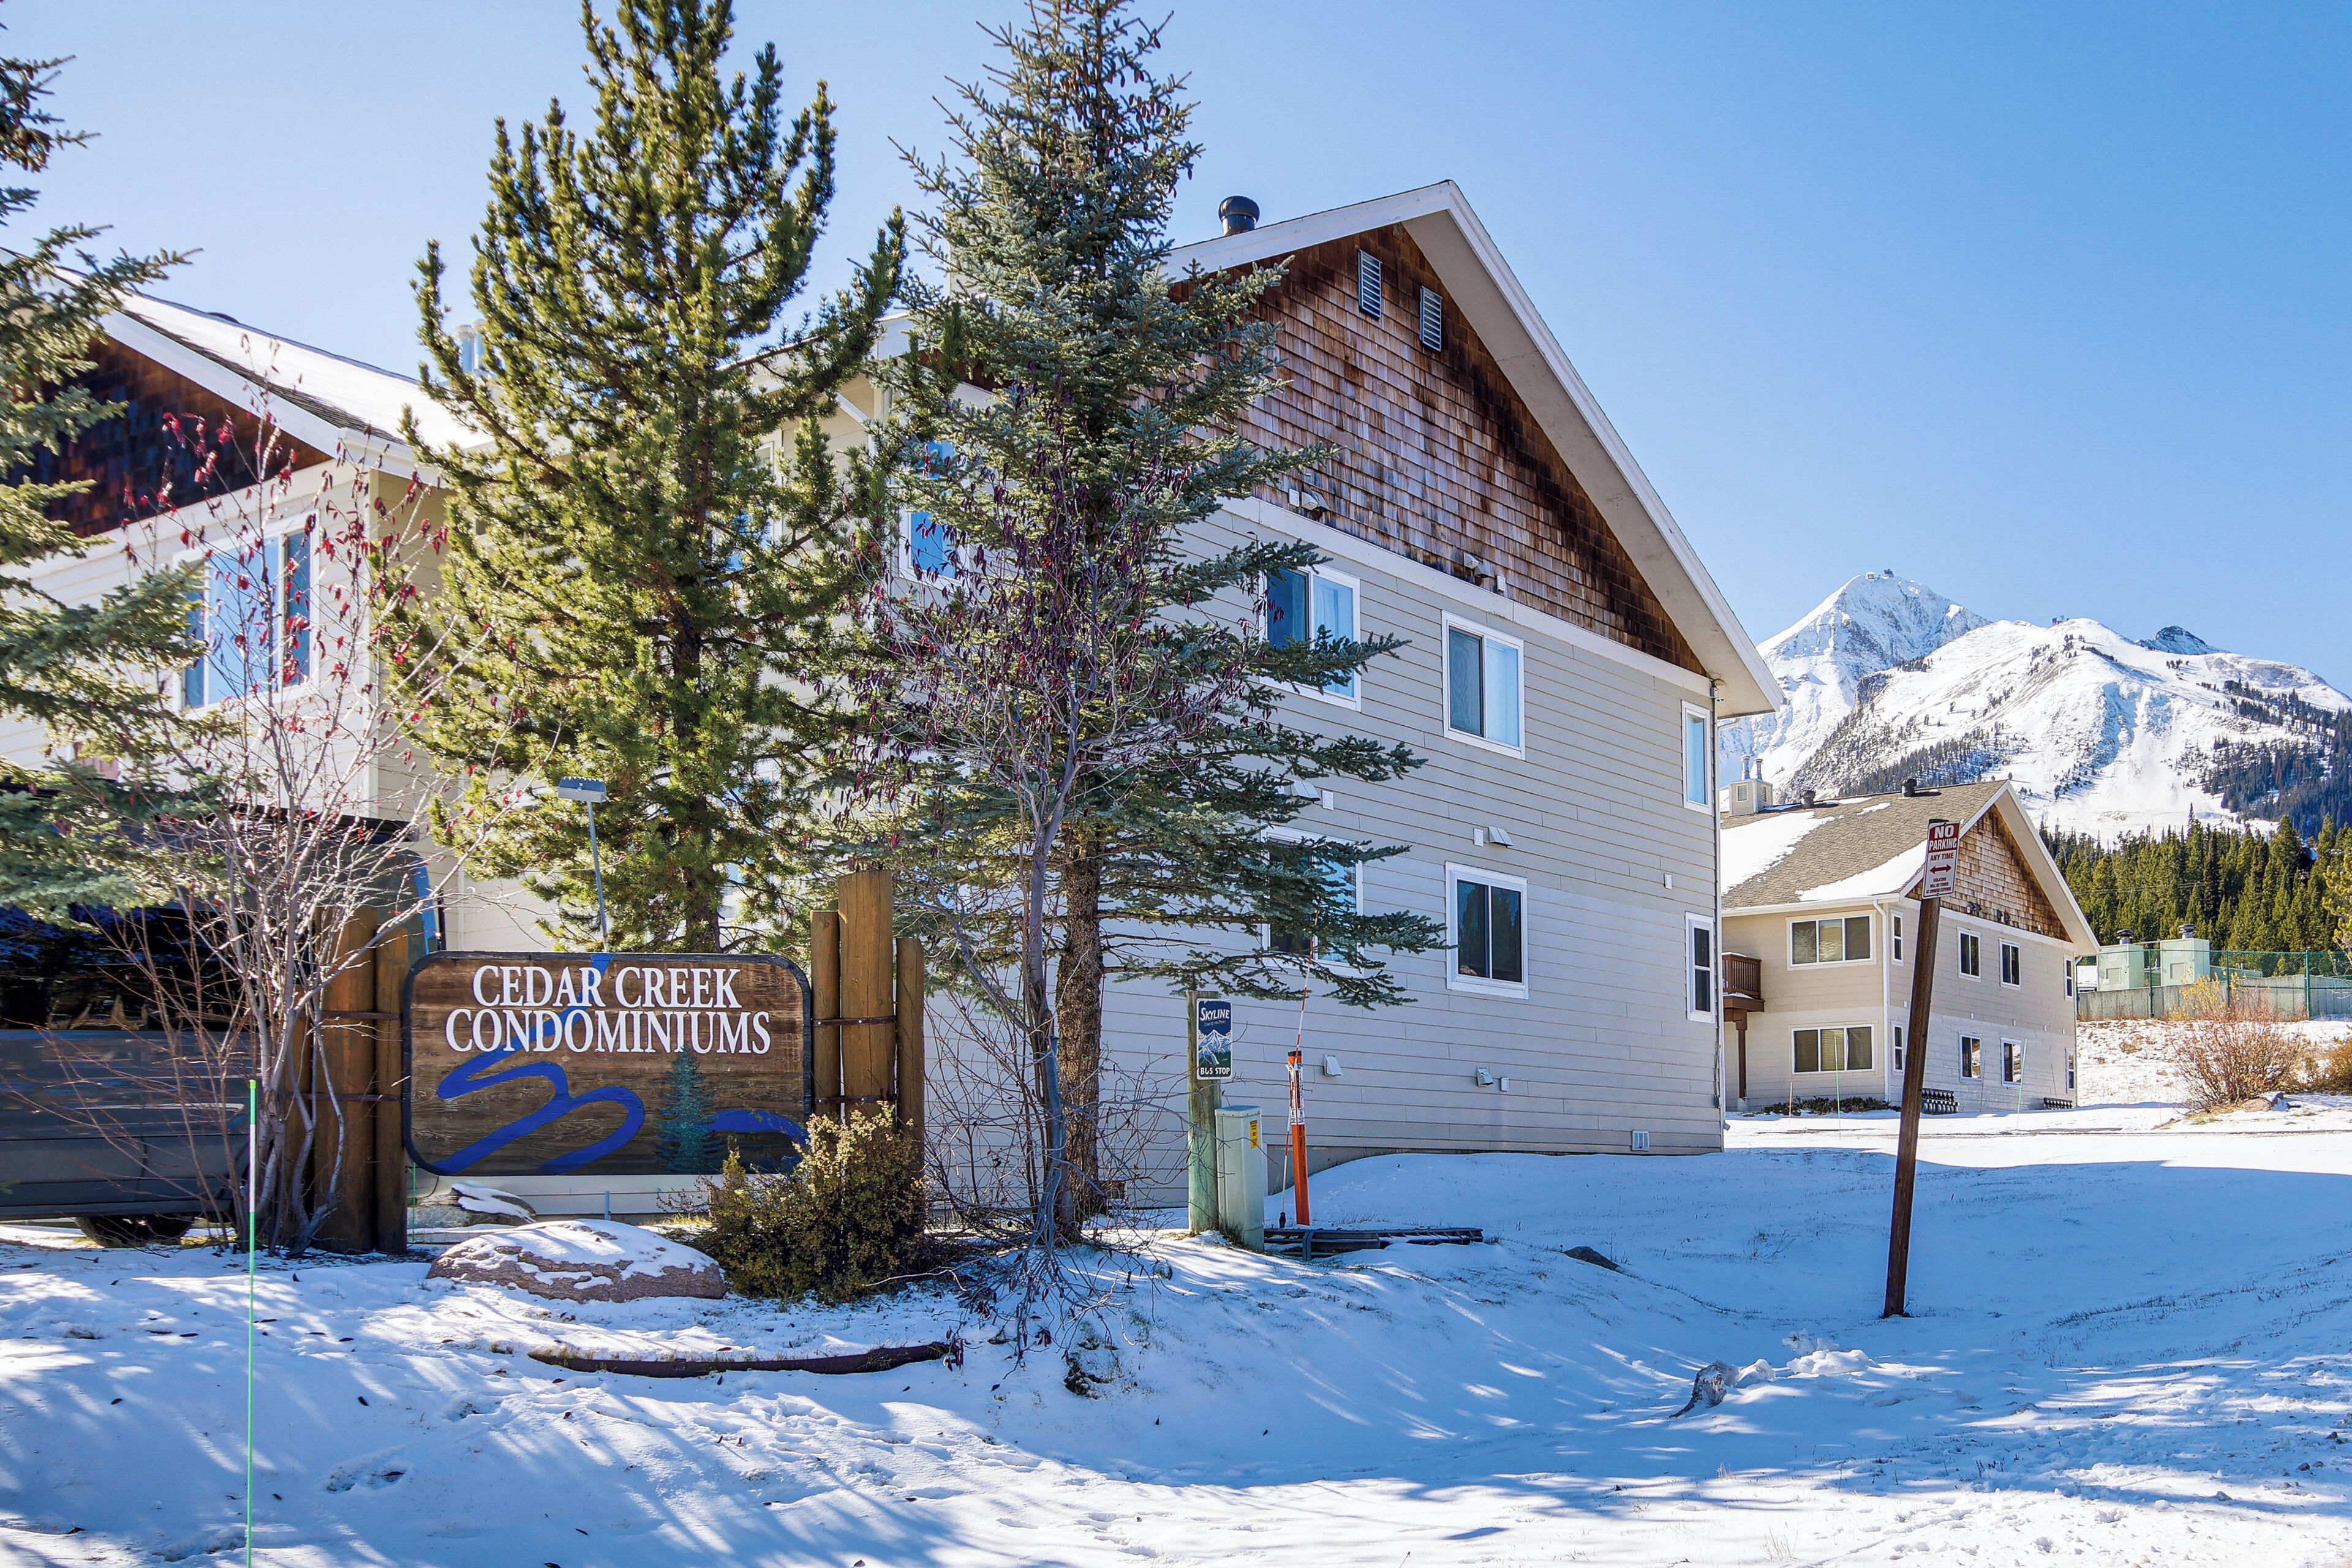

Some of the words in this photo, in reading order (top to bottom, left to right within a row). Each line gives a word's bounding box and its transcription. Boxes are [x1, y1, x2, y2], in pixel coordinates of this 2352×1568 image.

[1934, 825, 1954, 839] NO
[1929, 837, 1958, 851] PARKING
[473, 965, 606, 1008] CEDAR
[614, 966, 742, 1008] CREEK
[1200, 1007, 1230, 1021] SKYLINE
[445, 1008, 771, 1054] CONDOMINIUMS
